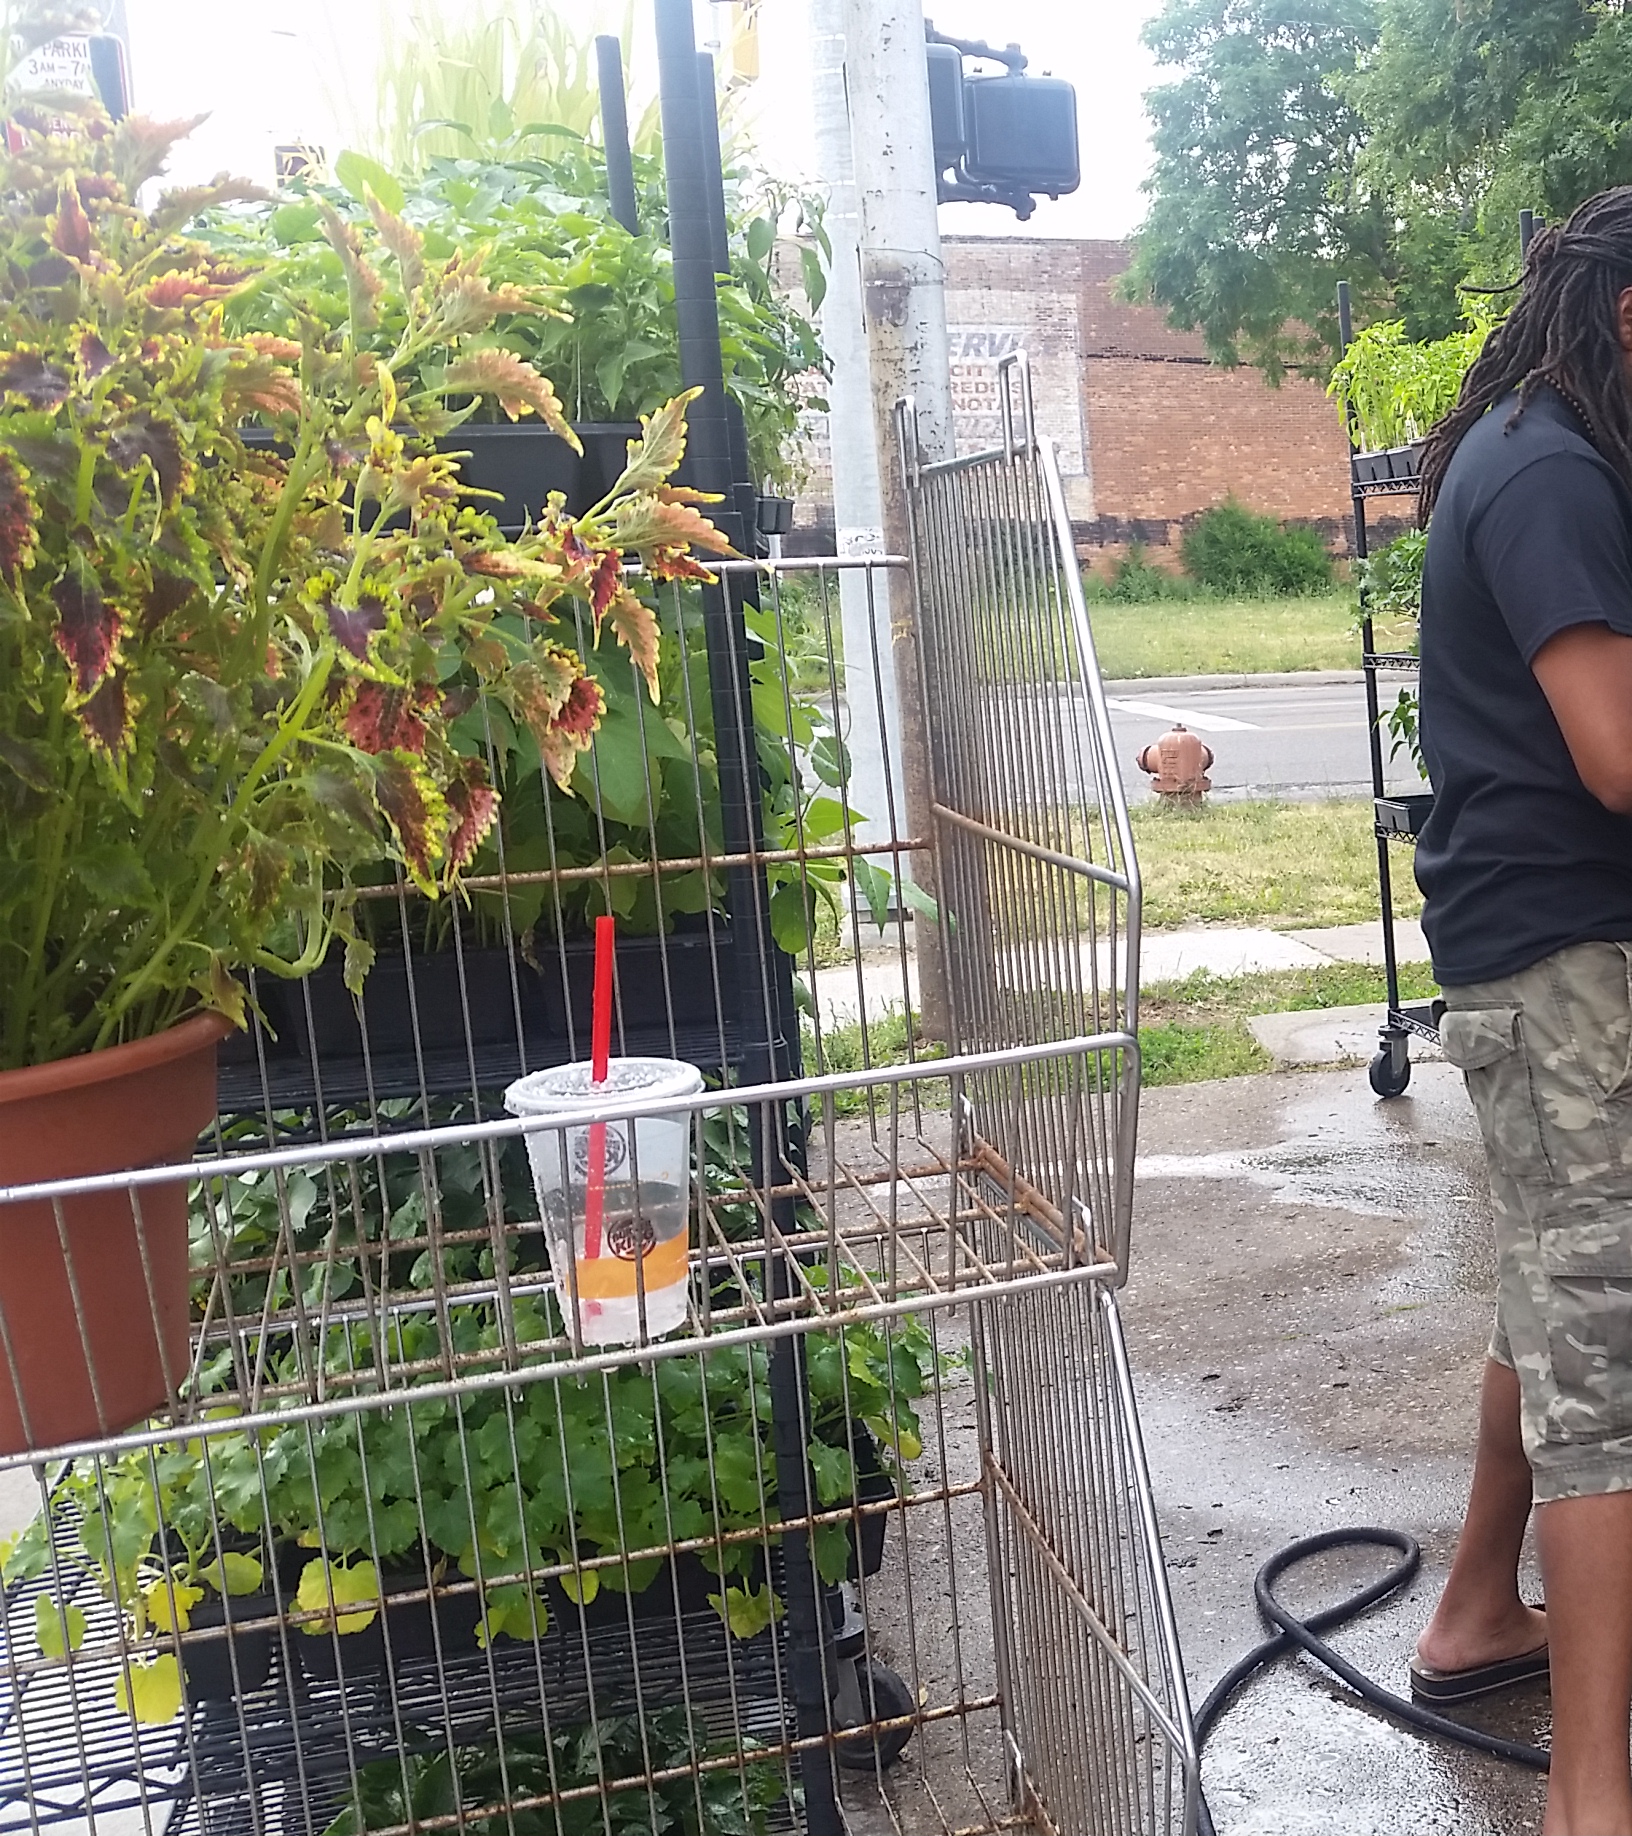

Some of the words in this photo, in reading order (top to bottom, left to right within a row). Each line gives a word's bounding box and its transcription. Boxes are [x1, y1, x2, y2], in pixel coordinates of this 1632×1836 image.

[42, 41, 88, 58] PARKI
[28, 58, 56, 75] 3AM
[950, 381, 1022, 394] REDIS
